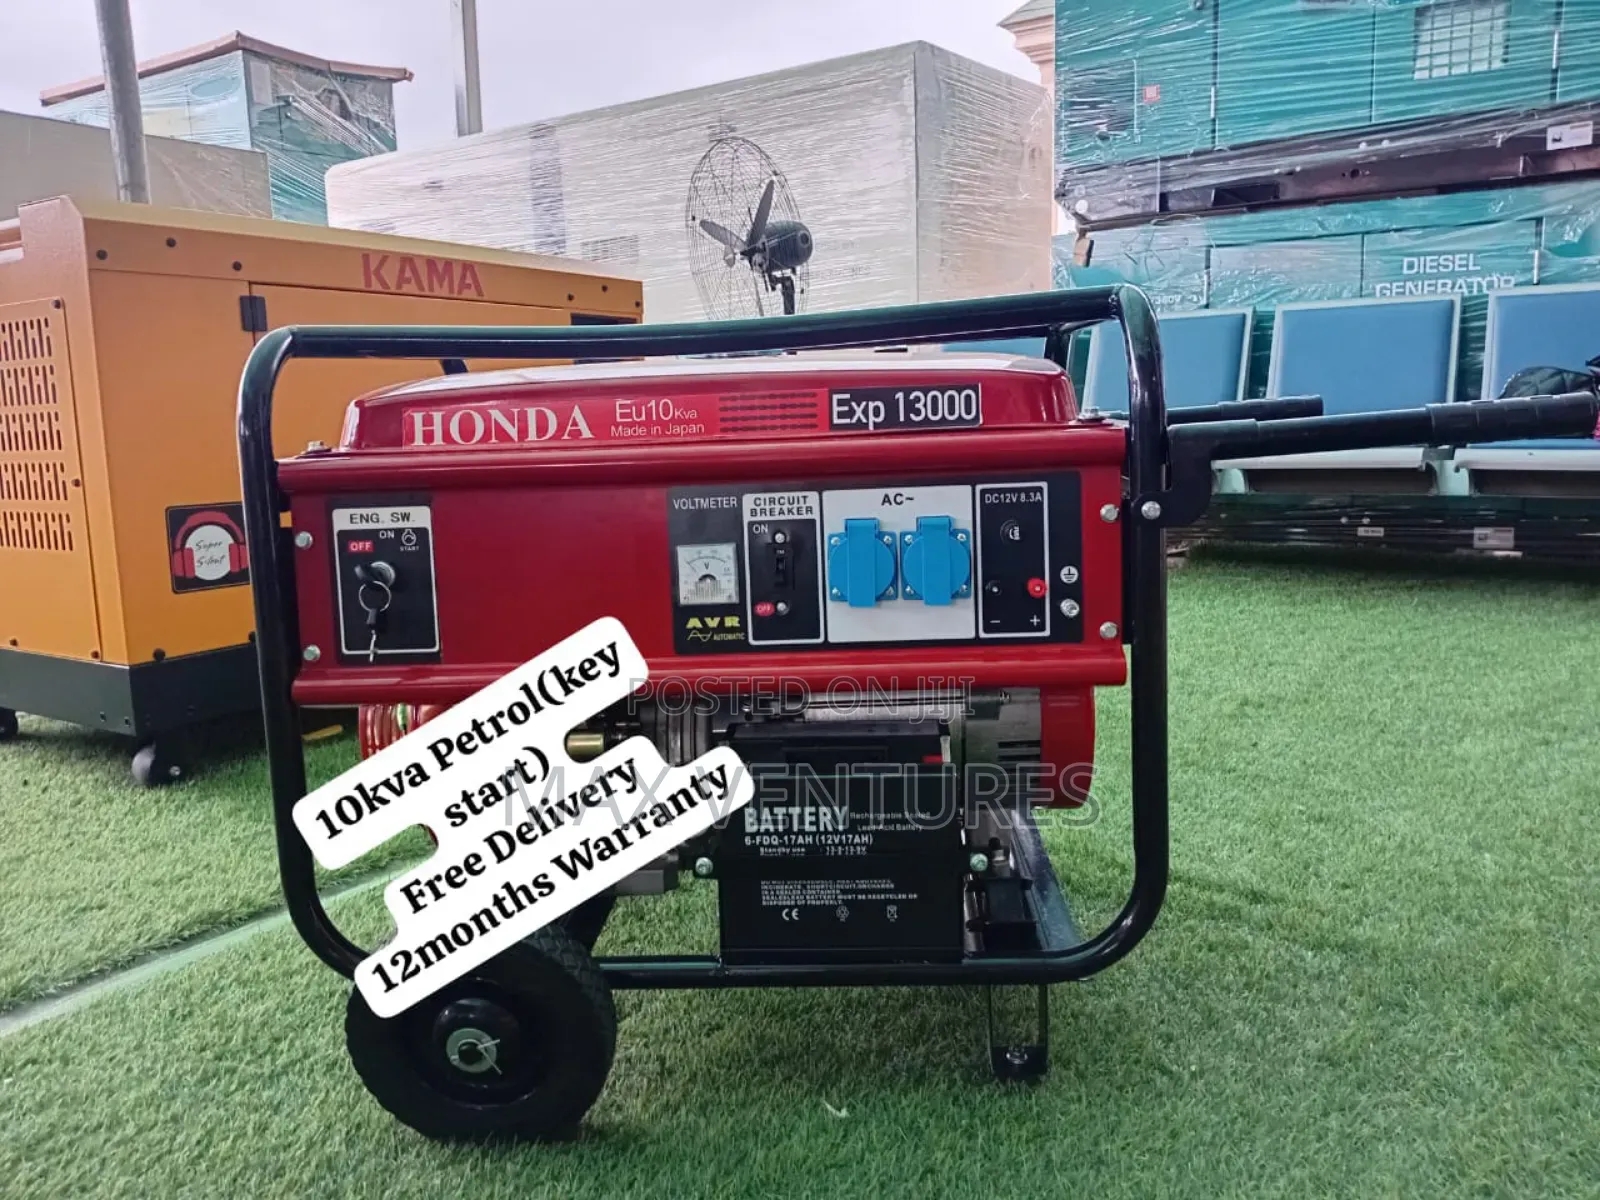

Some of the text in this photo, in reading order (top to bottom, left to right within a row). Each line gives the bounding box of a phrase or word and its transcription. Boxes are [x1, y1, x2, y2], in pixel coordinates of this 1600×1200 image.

[1402, 253, 1481, 275] DIESEL
[361, 253, 485, 297] KAMA
[832, 389, 977, 431] Exp 13000
[410, 404, 595, 447] HONDA
[611, 422, 705, 439] Made in Japan
[673, 496, 738, 510] VOLTMETER
[753, 495, 809, 507] CIRCUIT
[985, 492, 1042, 504] DC12V 8.3A
[750, 506, 814, 517] BREAKER
[350, 512, 416, 525] ENG. SW.
[379, 530, 395, 540] ON
[752, 523, 769, 534] ON
[349, 541, 372, 552] OFF
[686, 616, 741, 629] AVR
[713, 632, 745, 641] AUTOMATIC
[743, 806, 849, 833] BATTERY
[744, 834, 874, 847] 6-FDQ-17AH (12V17AH)
